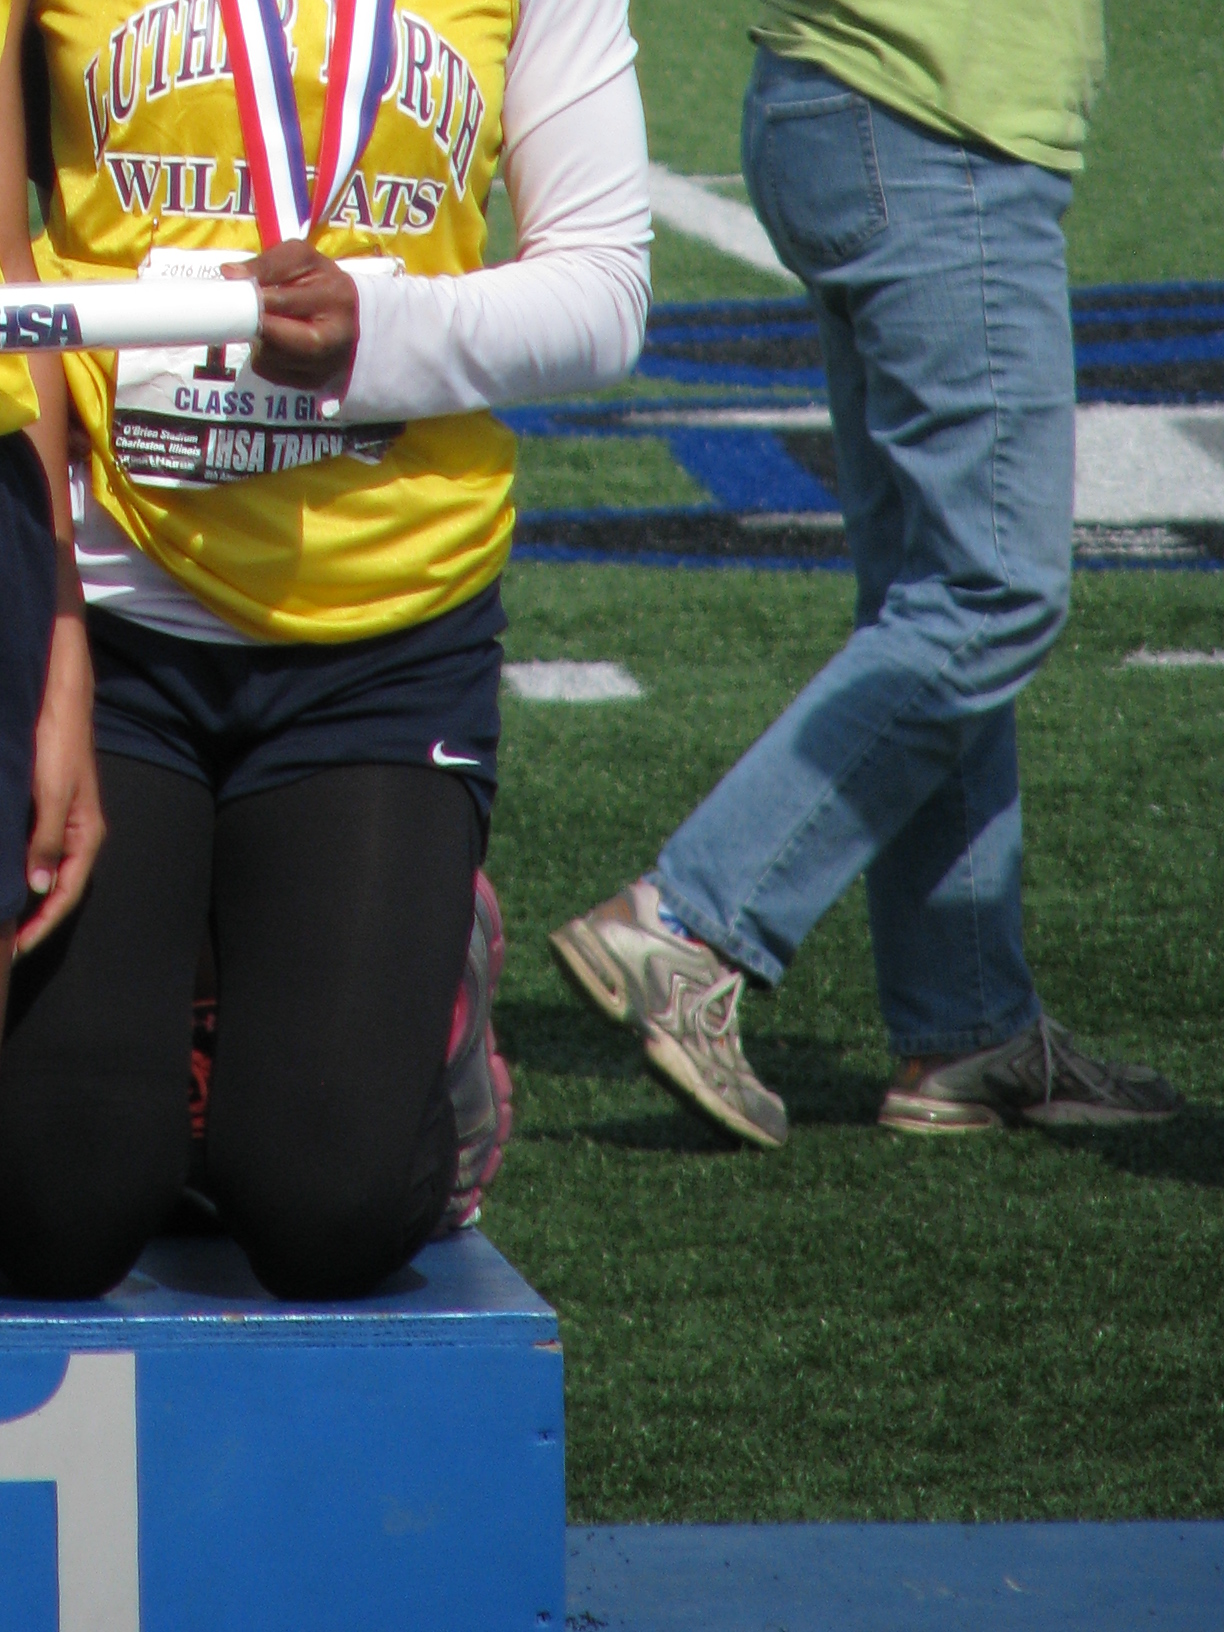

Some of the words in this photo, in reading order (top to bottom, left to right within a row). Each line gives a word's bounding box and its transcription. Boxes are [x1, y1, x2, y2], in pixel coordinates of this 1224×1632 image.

[104, 151, 448, 235] WILATS
[175, 386, 255, 416] CLASS
[265, 394, 288, 420] 1A
[205, 427, 266, 473] IHSA
